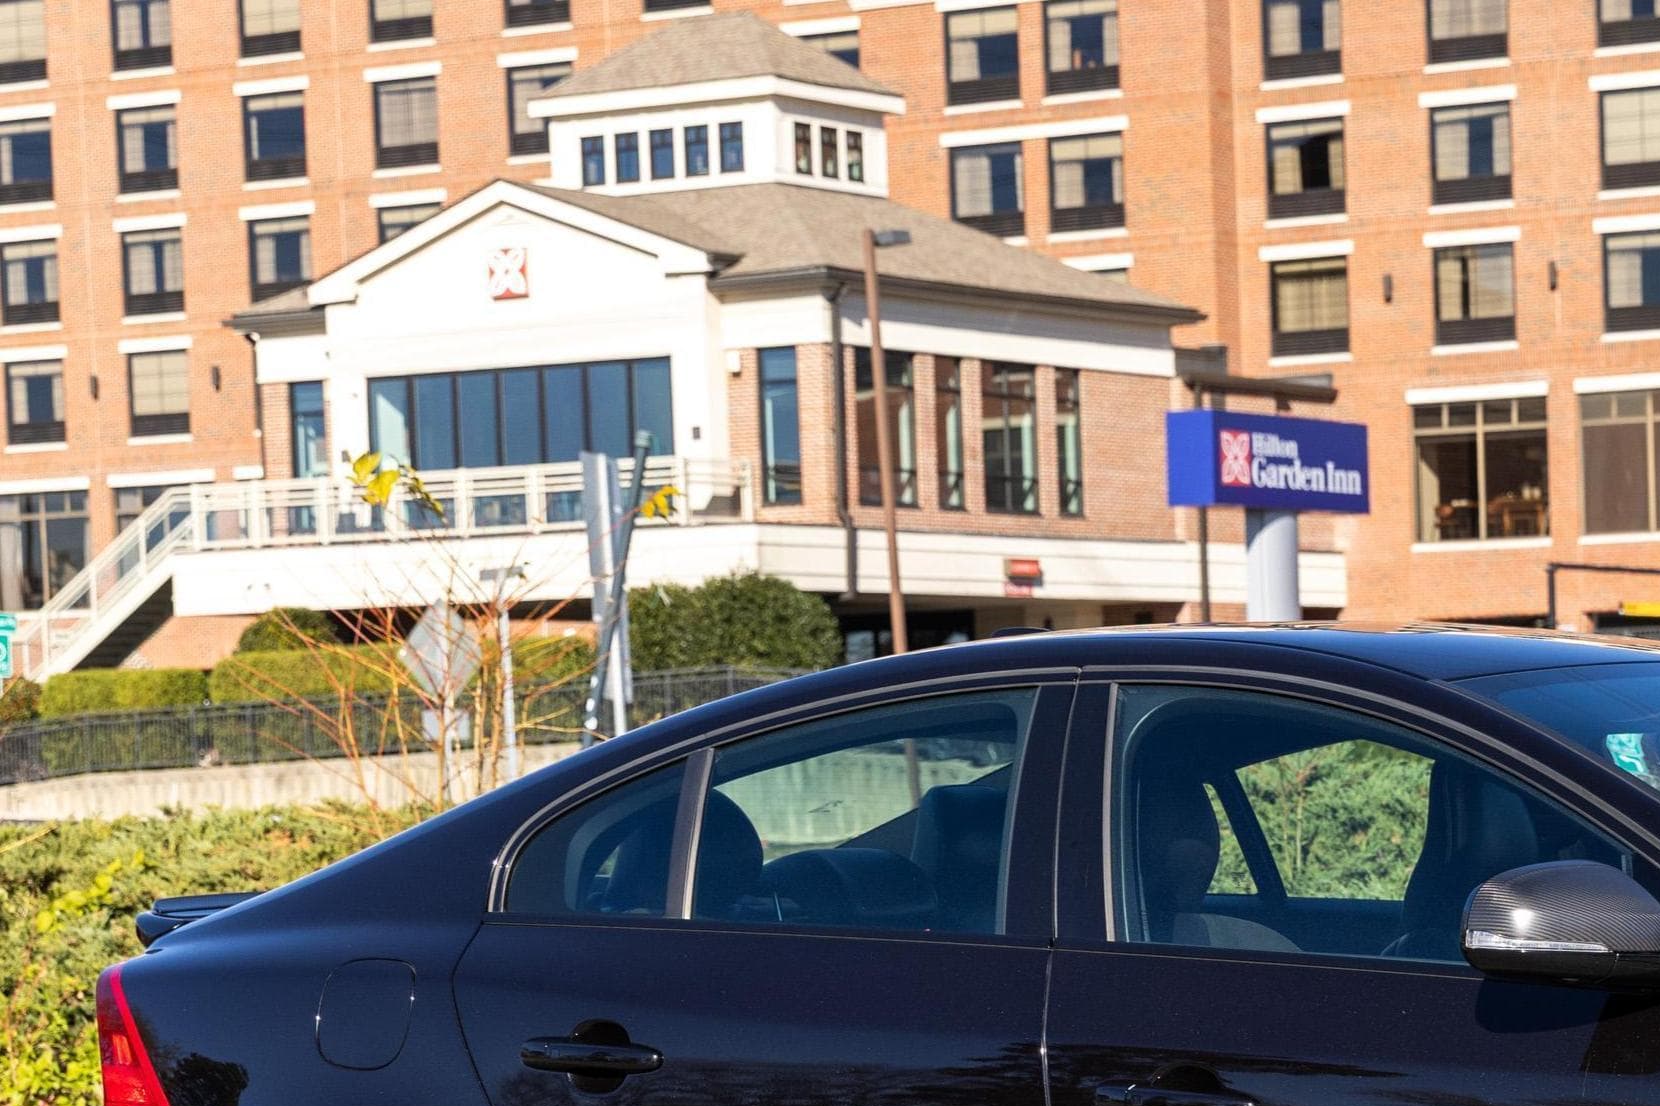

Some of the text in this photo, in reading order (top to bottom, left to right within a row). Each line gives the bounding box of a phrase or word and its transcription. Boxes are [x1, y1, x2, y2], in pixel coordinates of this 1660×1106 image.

[1252, 432, 1298, 459] Hilton
[1252, 457, 1362, 495] Garden Inn
